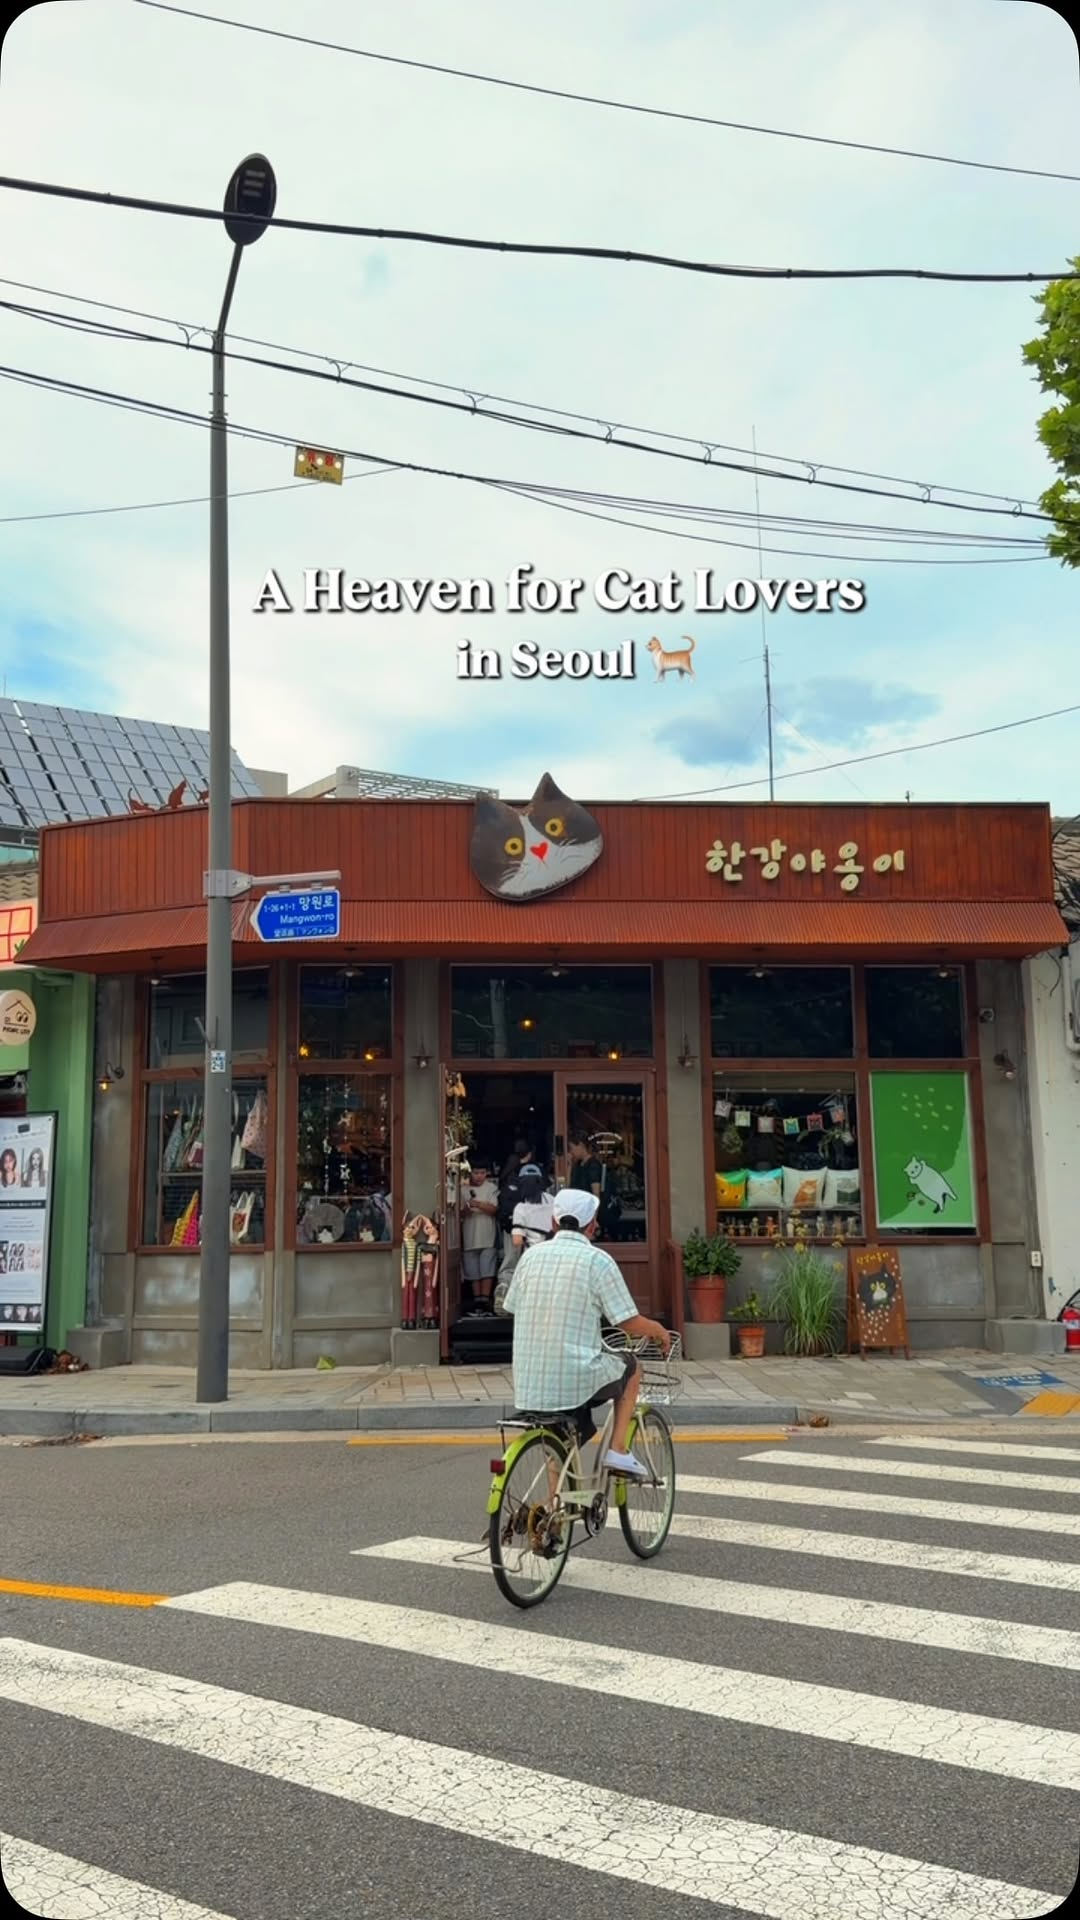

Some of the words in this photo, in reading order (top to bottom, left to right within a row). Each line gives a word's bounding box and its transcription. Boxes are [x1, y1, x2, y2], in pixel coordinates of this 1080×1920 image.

[705, 838, 905, 891] 한강야옹이
[299, 895, 335, 911] 망원로
[280, 913, 335, 925] Mangwon-ro
